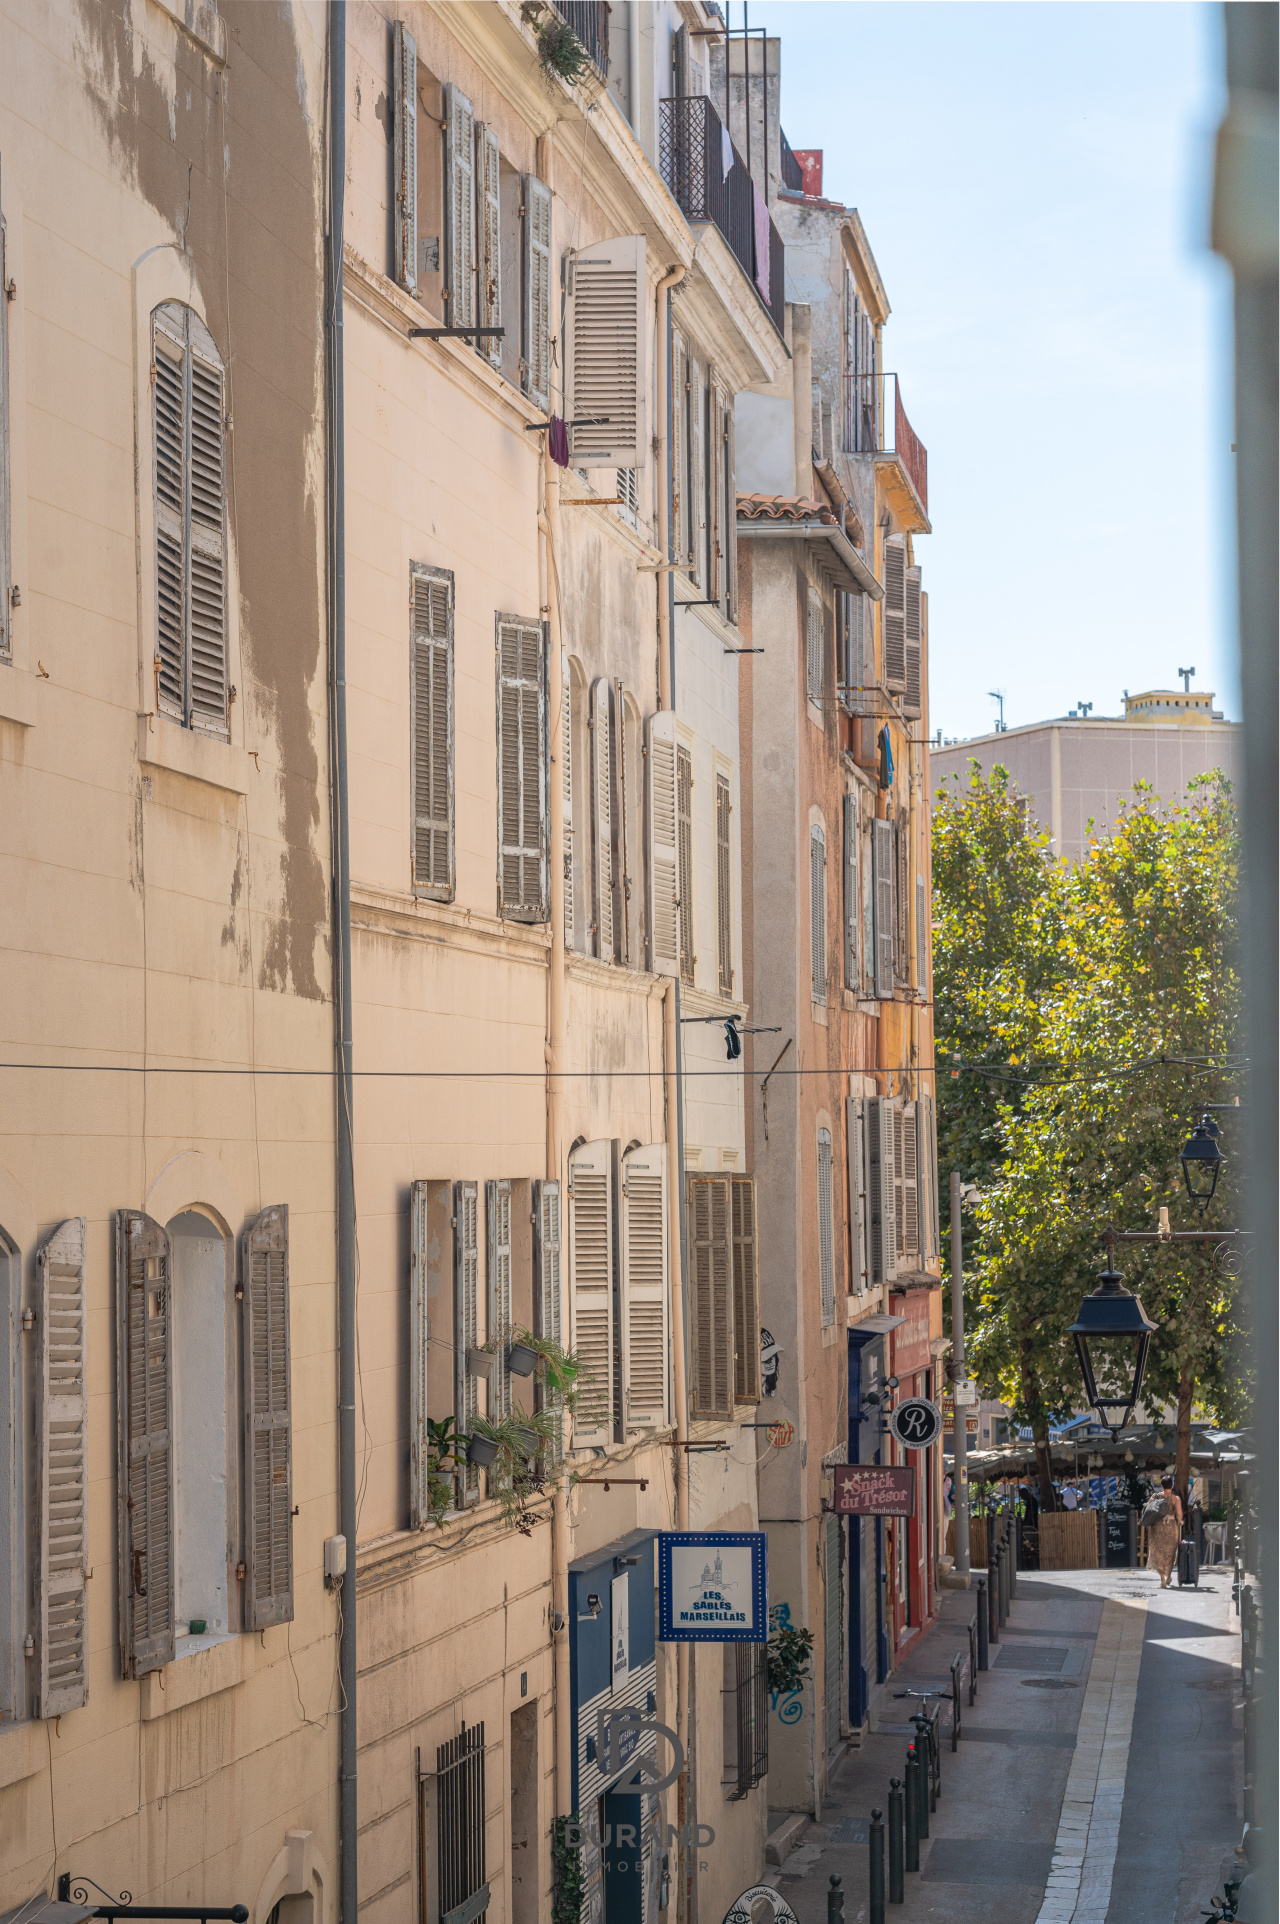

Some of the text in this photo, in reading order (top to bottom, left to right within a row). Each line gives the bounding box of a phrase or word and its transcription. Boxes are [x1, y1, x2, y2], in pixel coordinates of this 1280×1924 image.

[896, 1399, 914, 1411] BIJOUX
[917, 1399, 936, 1412] COQUES
[891, 1414, 906, 1445] ACCESSOIRES
[904, 1407, 928, 1437] R
[909, 1415, 940, 1448] PERSONNALISATION
[851, 1471, 895, 1495] Snack
[840, 1489, 908, 1509] du Trésor
[869, 1505, 907, 1515] Sandwiches
[703, 1590, 722, 1601] LES
[680, 1611, 746, 1622] MARSEILLAIS
